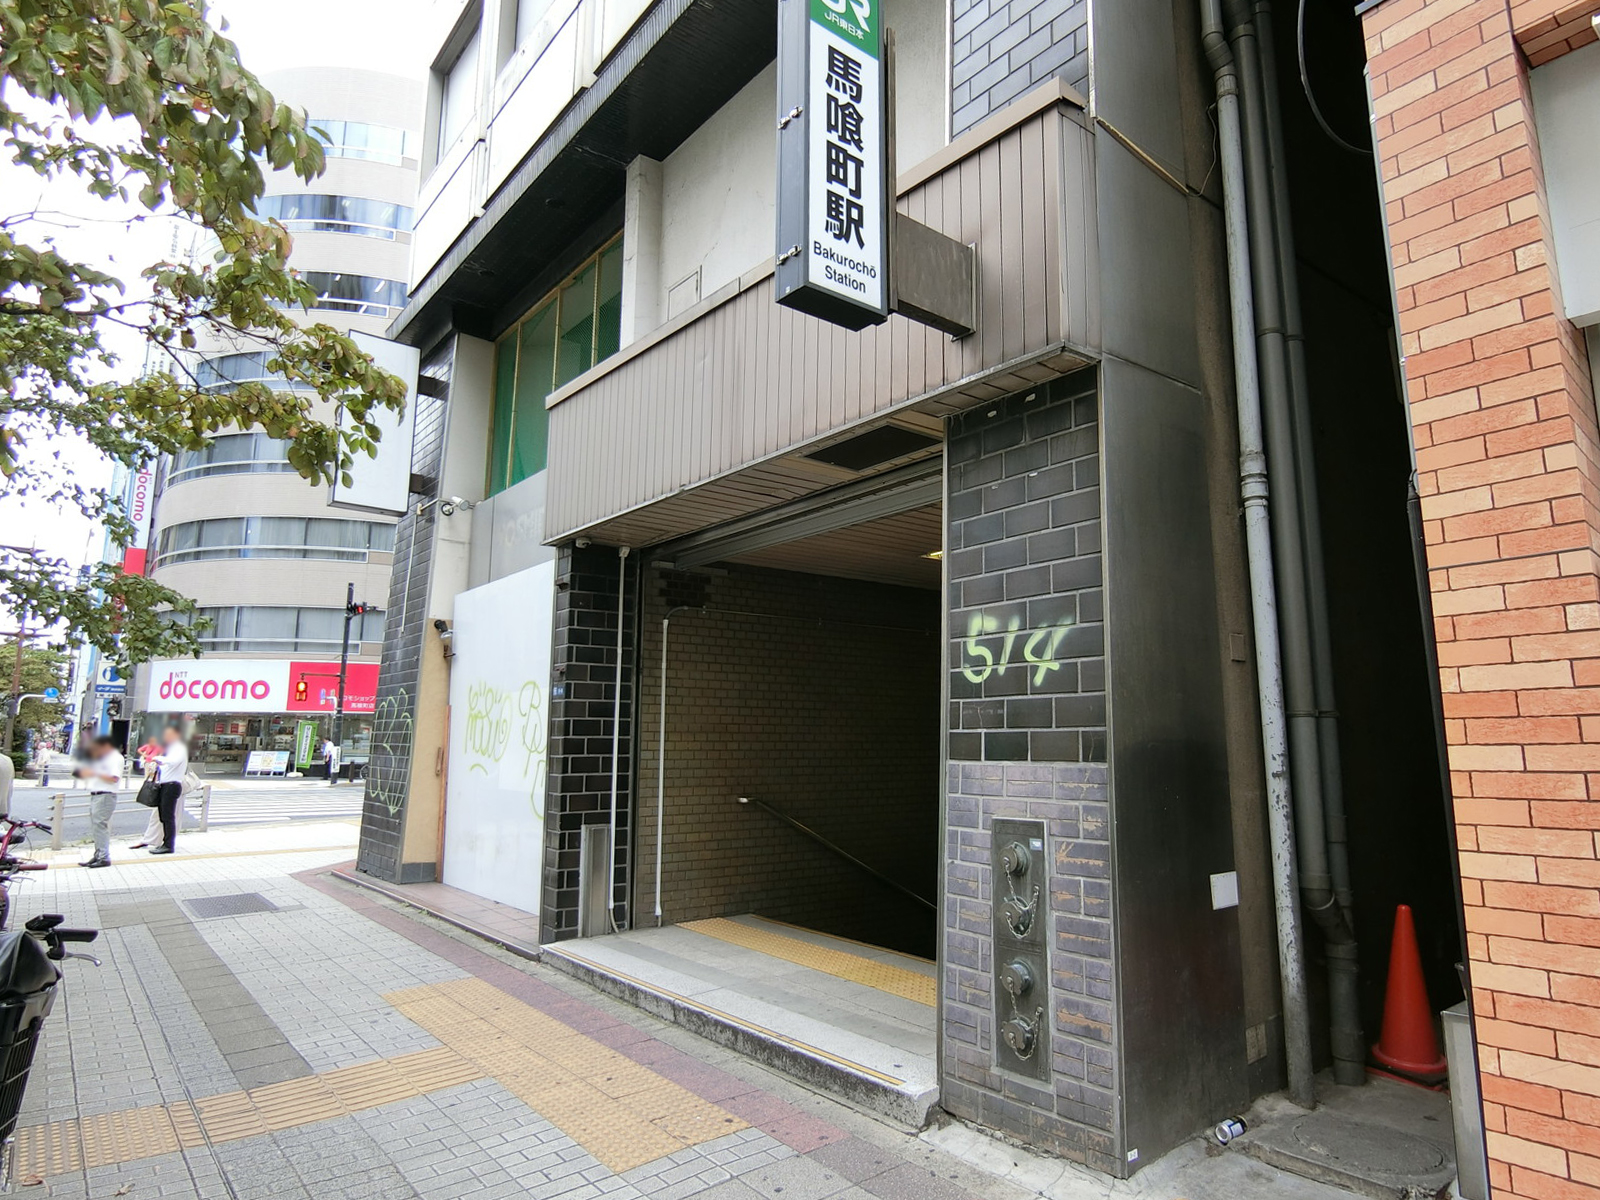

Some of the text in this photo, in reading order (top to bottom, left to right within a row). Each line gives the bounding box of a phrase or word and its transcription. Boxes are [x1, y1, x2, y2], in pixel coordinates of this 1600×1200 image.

[824, 11, 864, 40] JR東日本
[825, 44, 865, 250] 馬喰町駅
[814, 240, 877, 279] Bakurochō
[825, 264, 866, 293] Station
[133, 467, 153, 521] docomo
[160, 672, 270, 700] docomo
